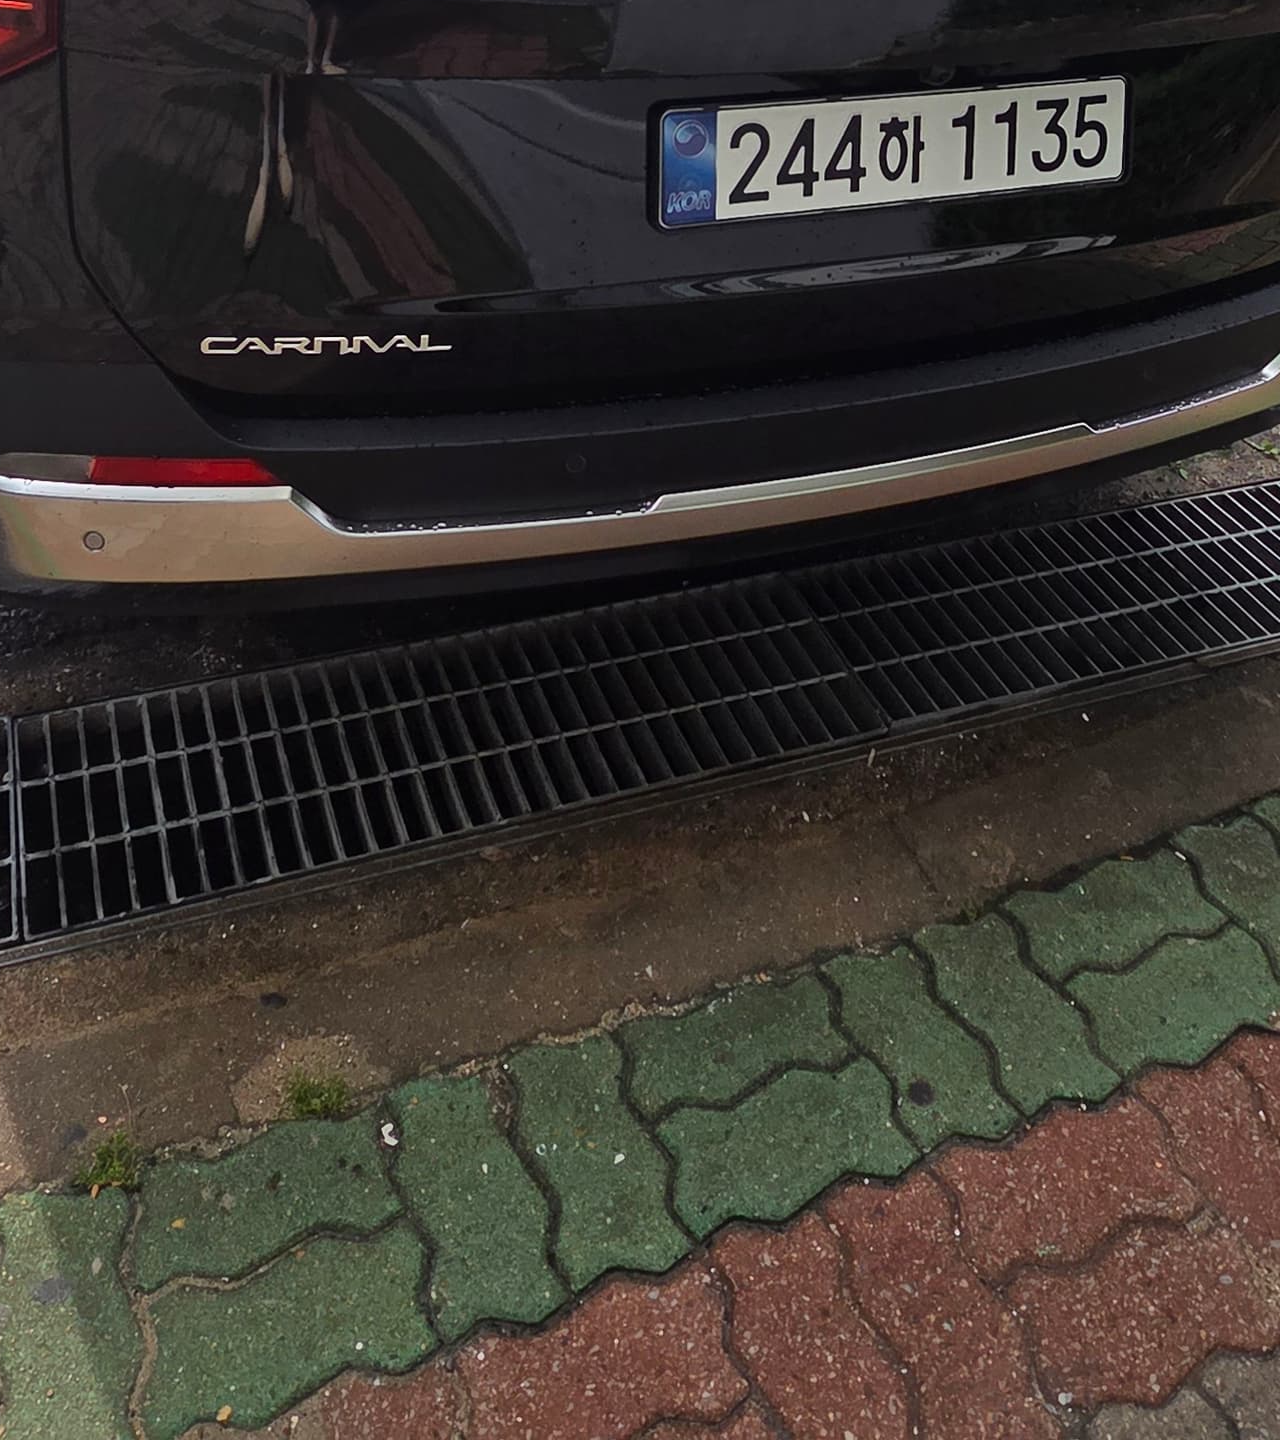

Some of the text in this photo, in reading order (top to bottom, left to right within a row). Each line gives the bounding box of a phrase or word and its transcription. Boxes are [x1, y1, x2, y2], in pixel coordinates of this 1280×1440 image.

[729, 94, 1108, 205] 244하 1135
[666, 190, 713, 213] KOR
[200, 334, 453, 355] CARNIVAL
